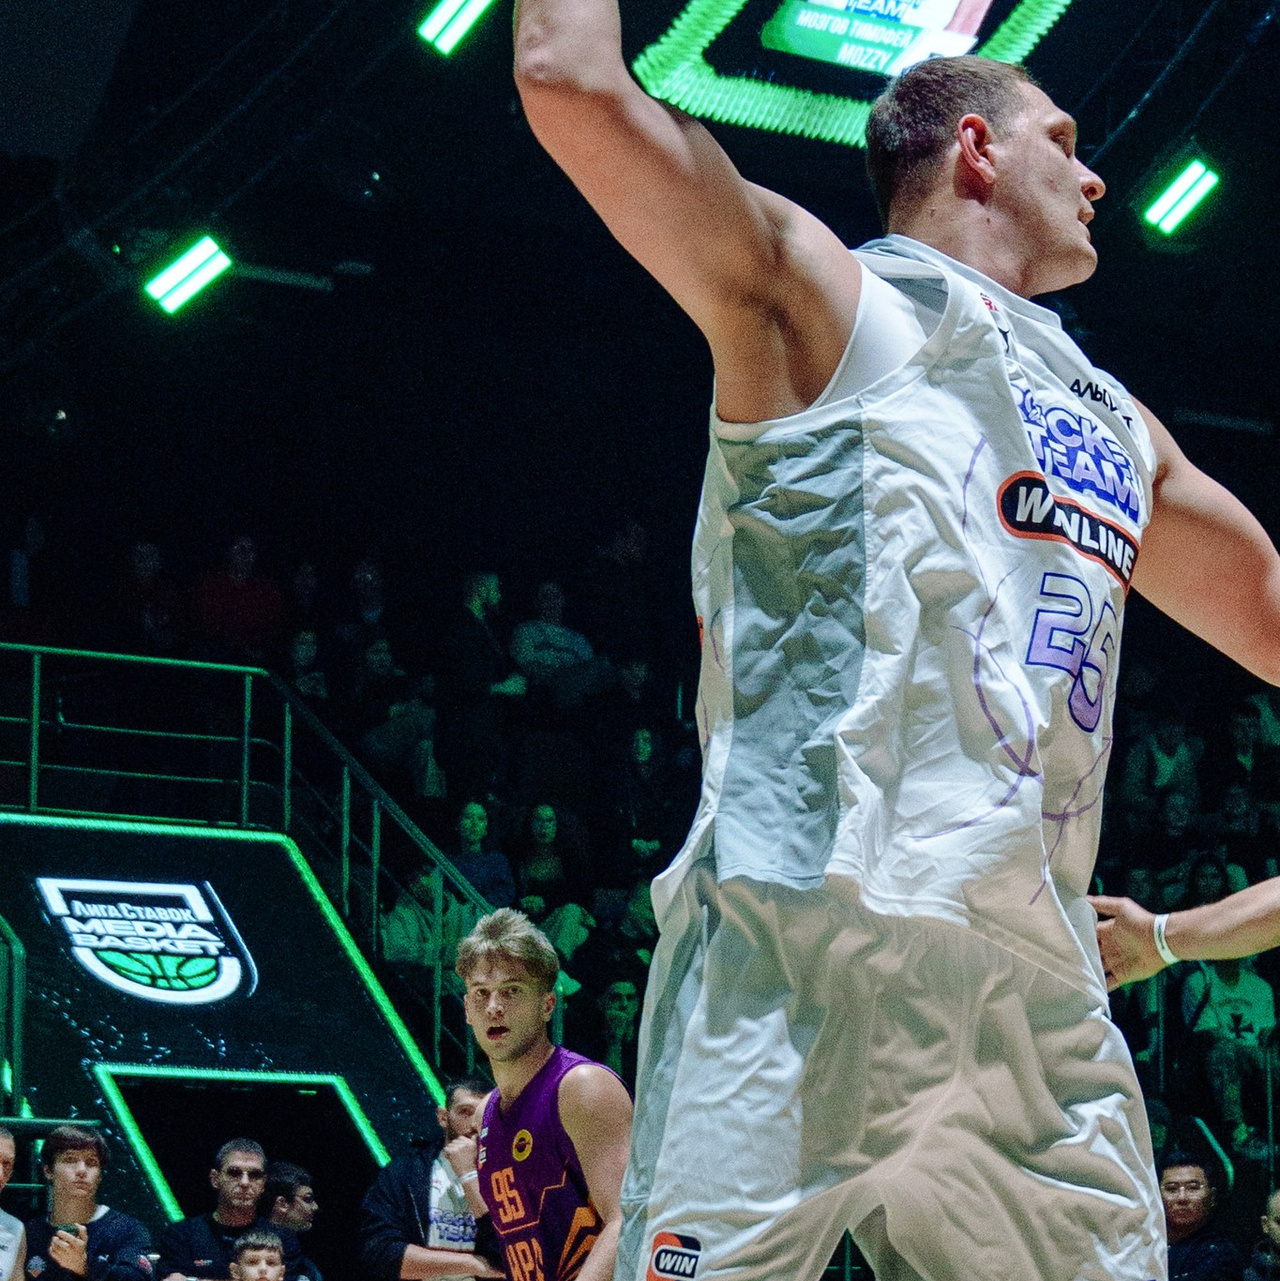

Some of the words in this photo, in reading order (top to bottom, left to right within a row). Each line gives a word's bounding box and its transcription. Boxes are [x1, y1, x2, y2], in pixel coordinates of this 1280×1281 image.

[796, 9, 847, 36] МОЗГОВ
[849, 20, 915, 49] ТИМОФЕЙ
[836, 43, 893, 70] MOZZY
[1022, 420, 1139, 523] TEAM
[1014, 483, 1137, 581] WNLINE
[61, 916, 221, 941] MEDIA
[71, 933, 226, 956] BASKET
[658, 1254, 698, 1276] WIN
